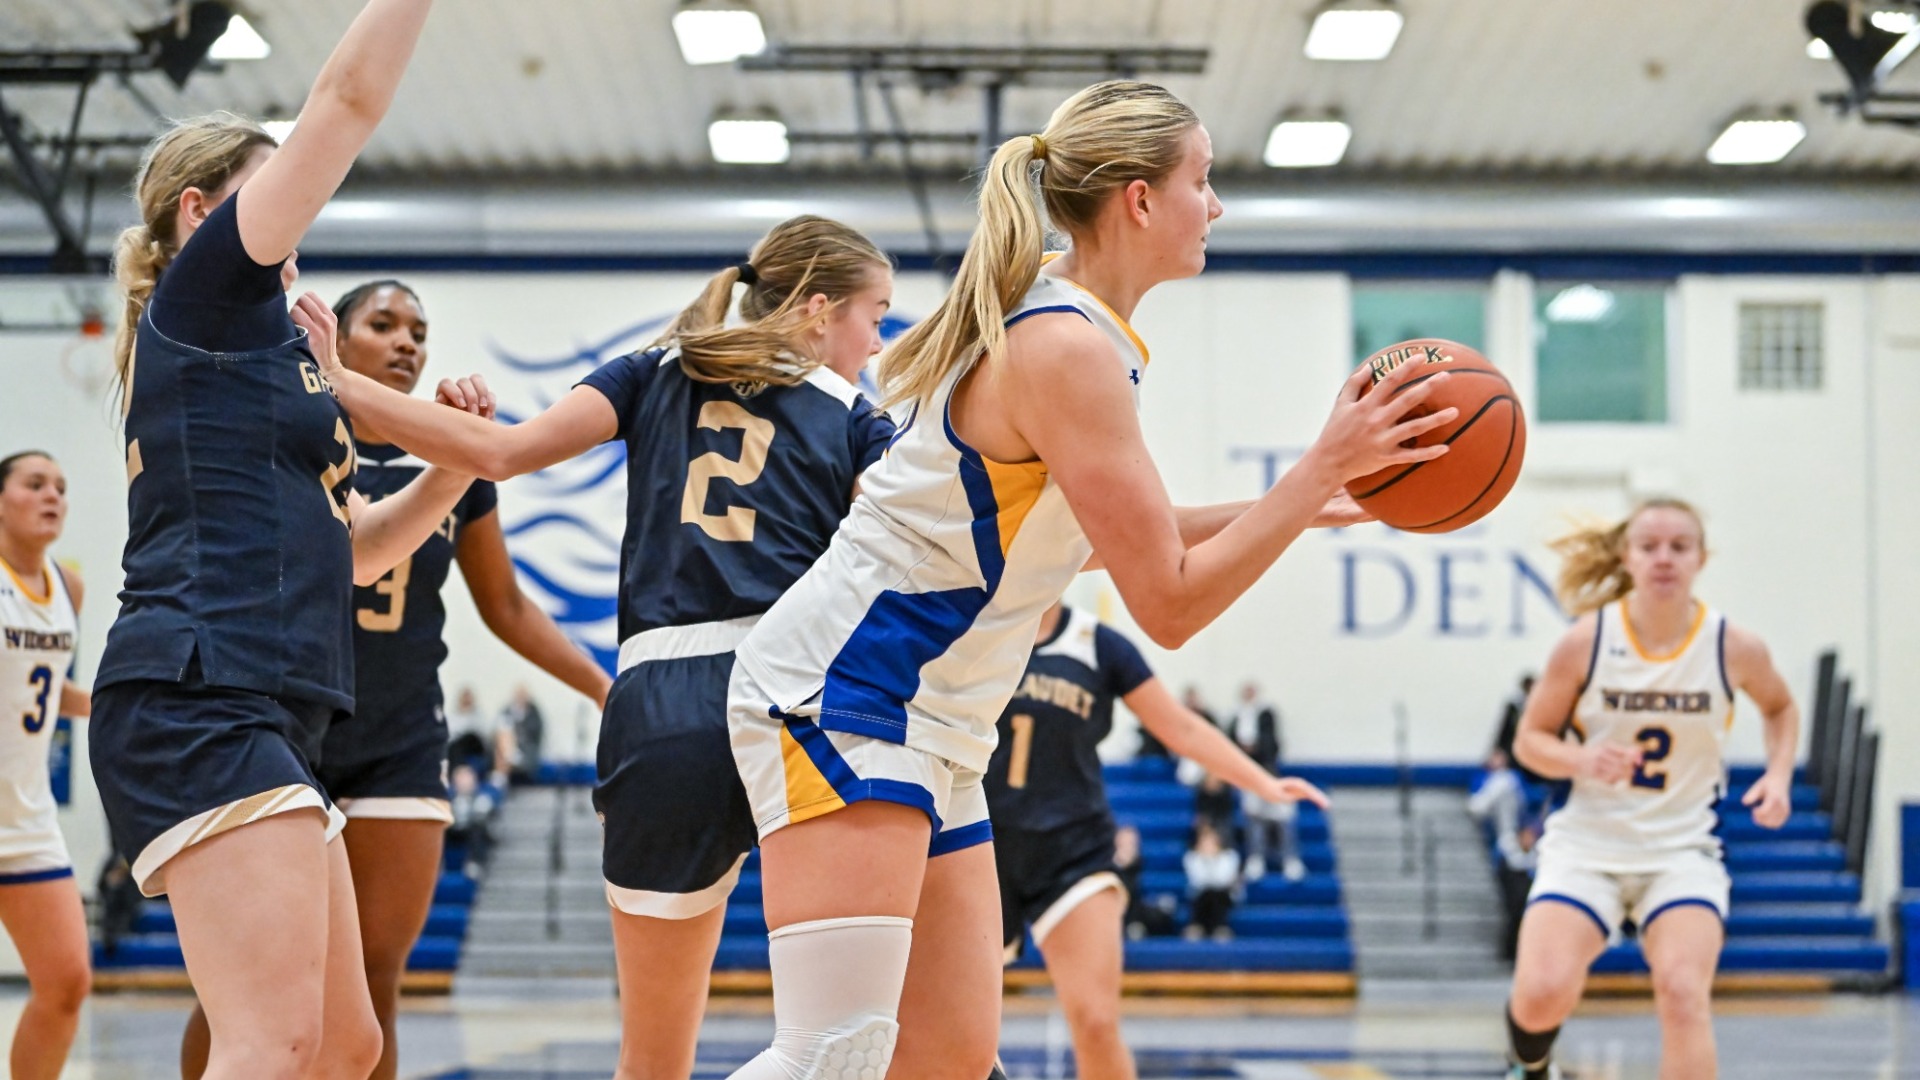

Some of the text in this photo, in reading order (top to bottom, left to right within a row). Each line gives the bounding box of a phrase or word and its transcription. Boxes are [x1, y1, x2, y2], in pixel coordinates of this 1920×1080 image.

[681, 400, 776, 542] 2
[22, 663, 53, 734] 3
[1601, 687, 1711, 713] WIDENER
[1007, 713, 1035, 789] 1
[1631, 725, 1674, 791] 2
